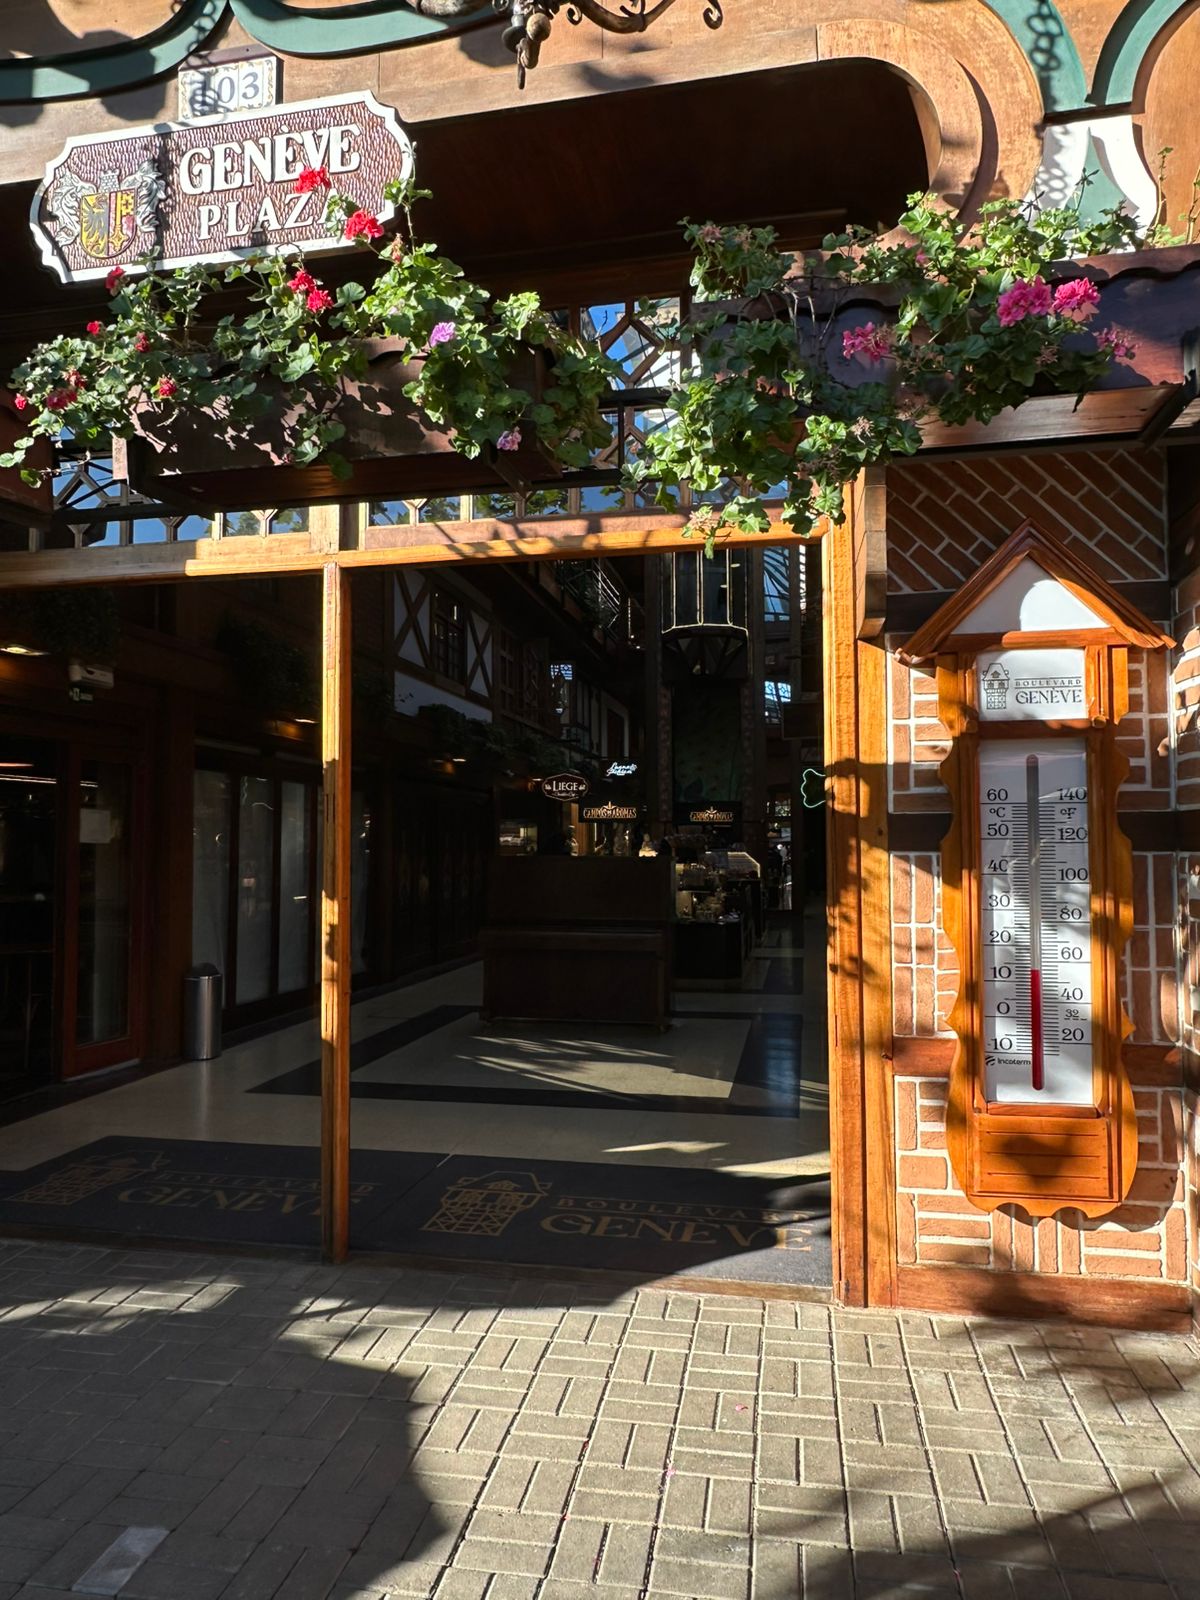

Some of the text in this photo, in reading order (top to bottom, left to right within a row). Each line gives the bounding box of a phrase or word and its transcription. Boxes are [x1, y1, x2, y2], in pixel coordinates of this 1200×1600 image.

[179, 123, 362, 196] GENÈVE
[1015, 679, 1082, 687] BOULEVARD
[1015, 687, 1083, 705] GENÈVE
[553, 781, 579, 792] LIEGE
[987, 788, 1008, 801] 60
[1057, 787, 1087, 801] 140
[989, 807, 1006, 818] °C
[987, 823, 1009, 837] 50
[1058, 827, 1088, 841] 120
[988, 859, 1009, 873] 40
[1058, 867, 1088, 881] 100
[989, 894, 1010, 908] 30
[1060, 907, 1082, 920] 80
[989, 930, 1011, 943] 20
[1061, 946, 1082, 960] 60
[990, 965, 1011, 979] 10
[1061, 987, 1083, 1001] 40
[997, 1001, 1010, 1015] 0
[1065, 1009, 1079, 1018] 32
[1062, 1028, 1084, 1041] 20
[997, 1057, 1031, 1066] Incoterm
[156, 1173, 375, 1194] BOULEVAD
